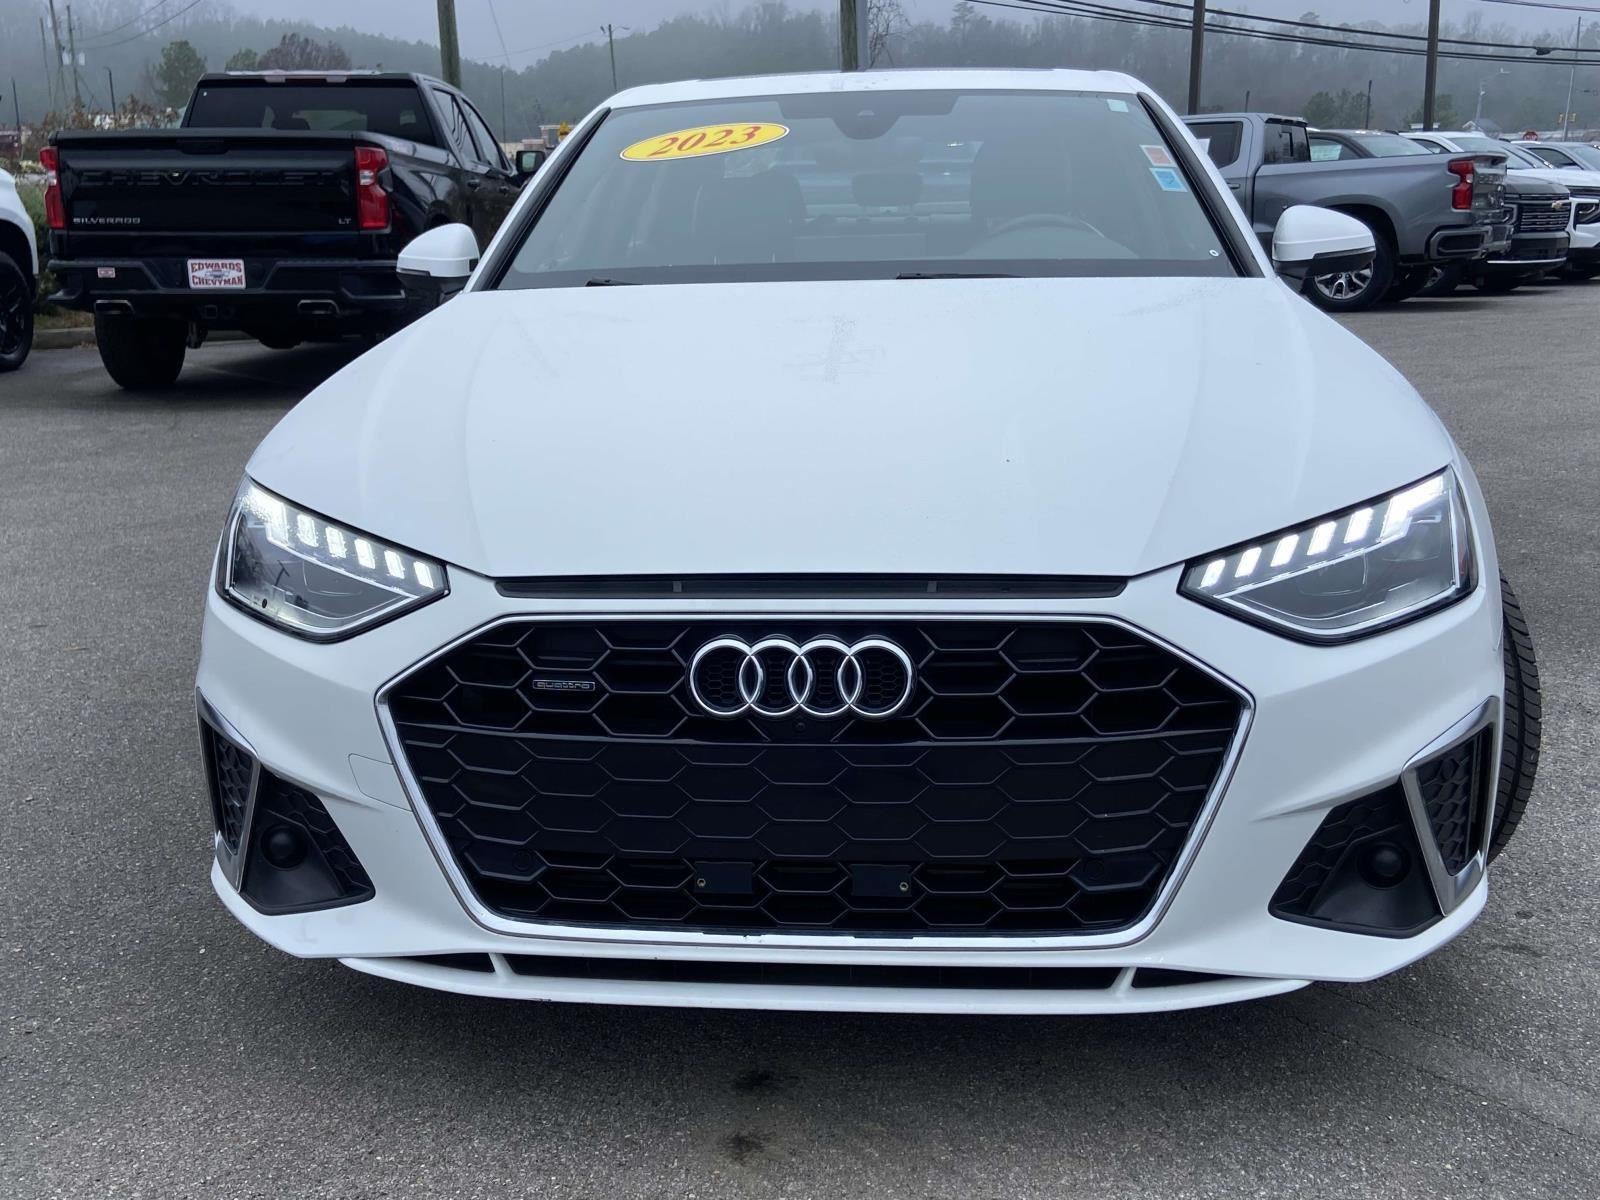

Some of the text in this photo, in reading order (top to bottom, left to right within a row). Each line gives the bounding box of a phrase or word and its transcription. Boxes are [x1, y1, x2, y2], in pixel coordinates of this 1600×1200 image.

[649, 126, 761, 157] 2023
[80, 170, 334, 187] CHEVROLET
[338, 217, 352, 225] LT
[190, 262, 242, 272] EDWARDS
[191, 275, 244, 286] CHEVYMAN
[536, 681, 590, 689] quattro
